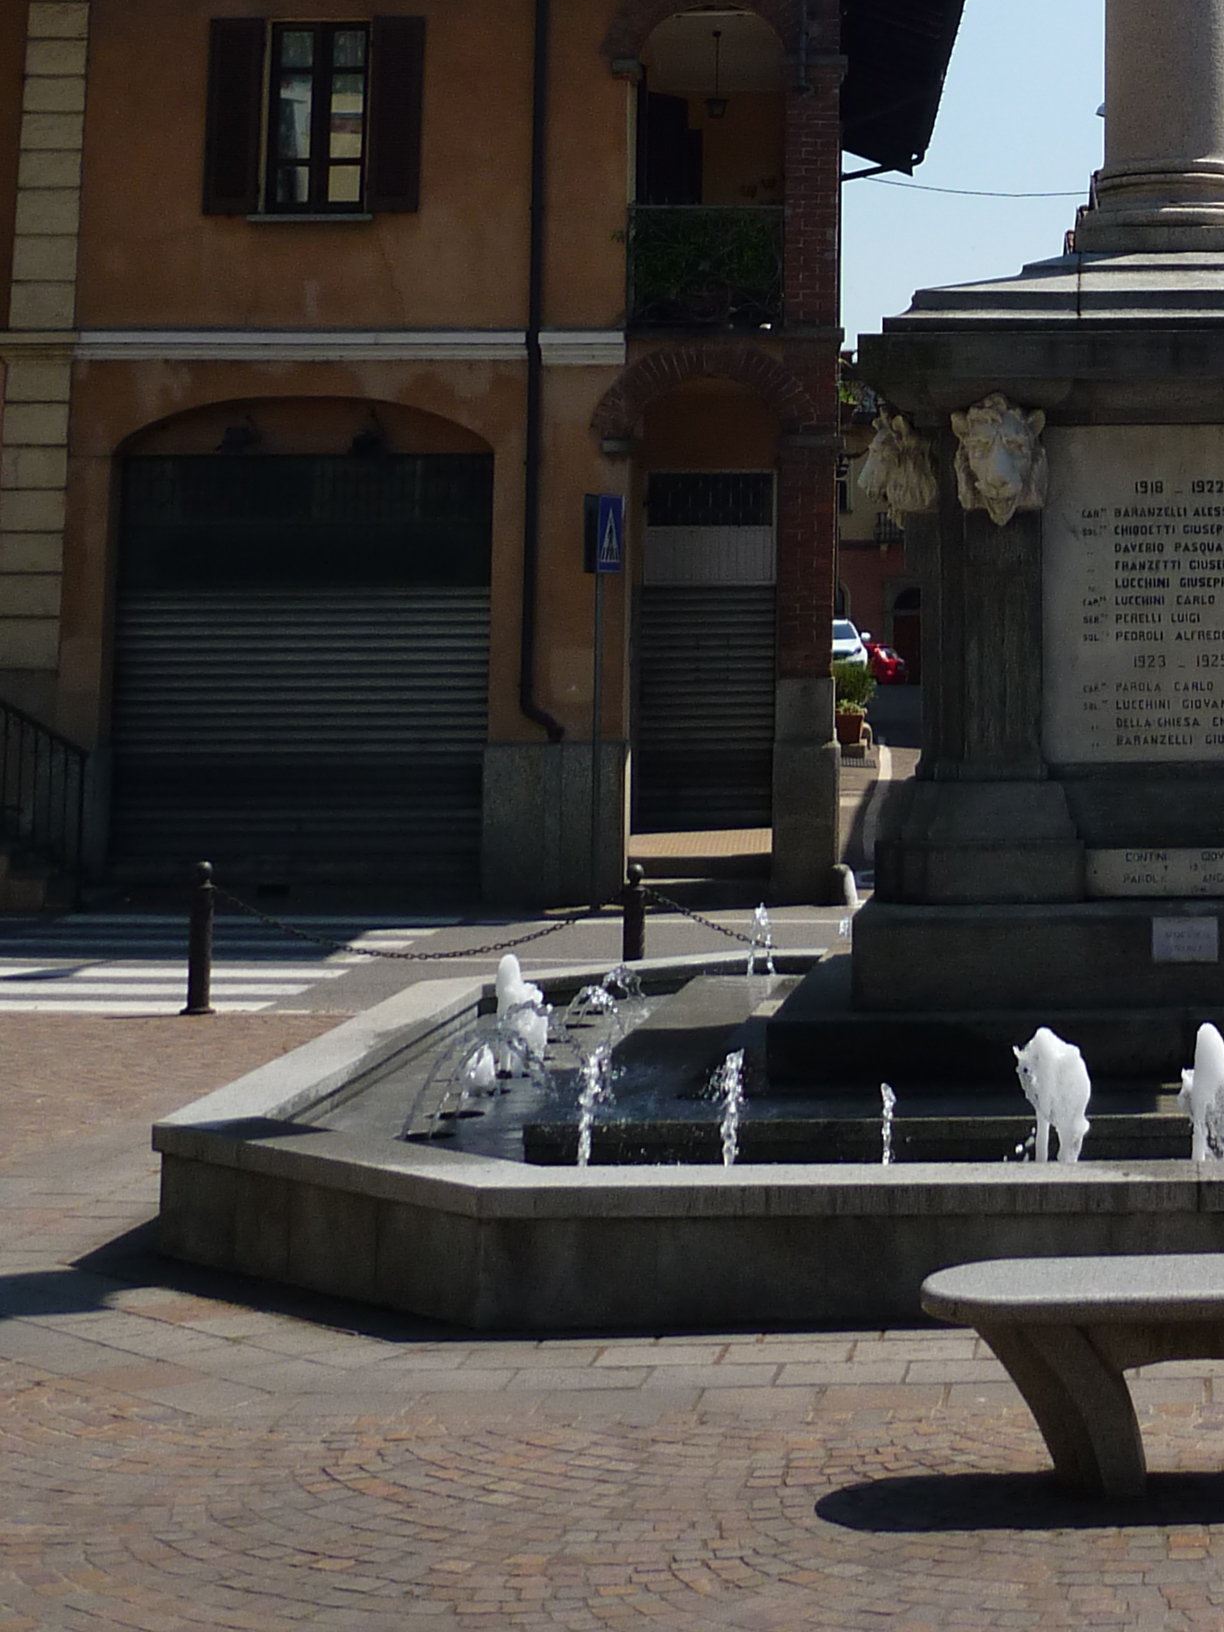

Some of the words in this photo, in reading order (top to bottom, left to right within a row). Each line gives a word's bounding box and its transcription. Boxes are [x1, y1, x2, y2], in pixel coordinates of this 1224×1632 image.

[1135, 480, 1164, 494] 1918
[1191, 480, 1224, 494] 1922
[1114, 506, 1188, 518] BARANZELLI
[1114, 524, 1175, 536] CHIODETTI
[1114, 542, 1164, 553] DAVERIO
[1114, 560, 1181, 571] FRANZETTI
[1115, 577, 1170, 589] LUCCHINI
[1115, 595, 1165, 606] LUCCHINI
[1176, 595, 1215, 605] CARLO
[1115, 613, 1162, 624] PERELLI
[1170, 613, 1201, 623] LUIGI
[1115, 631, 1164, 641] PEDROLI
[1134, 654, 1166, 668] 1923
[1115, 681, 1161, 692] PAROLA
[1174, 681, 1214, 692] CARLO
[1116, 699, 1170, 710] LUCCHINI
[1116, 717, 1152, 729] DELLA
[1157, 717, 1200, 728] CHIESA
[1116, 735, 1193, 747] BARANZELLI
